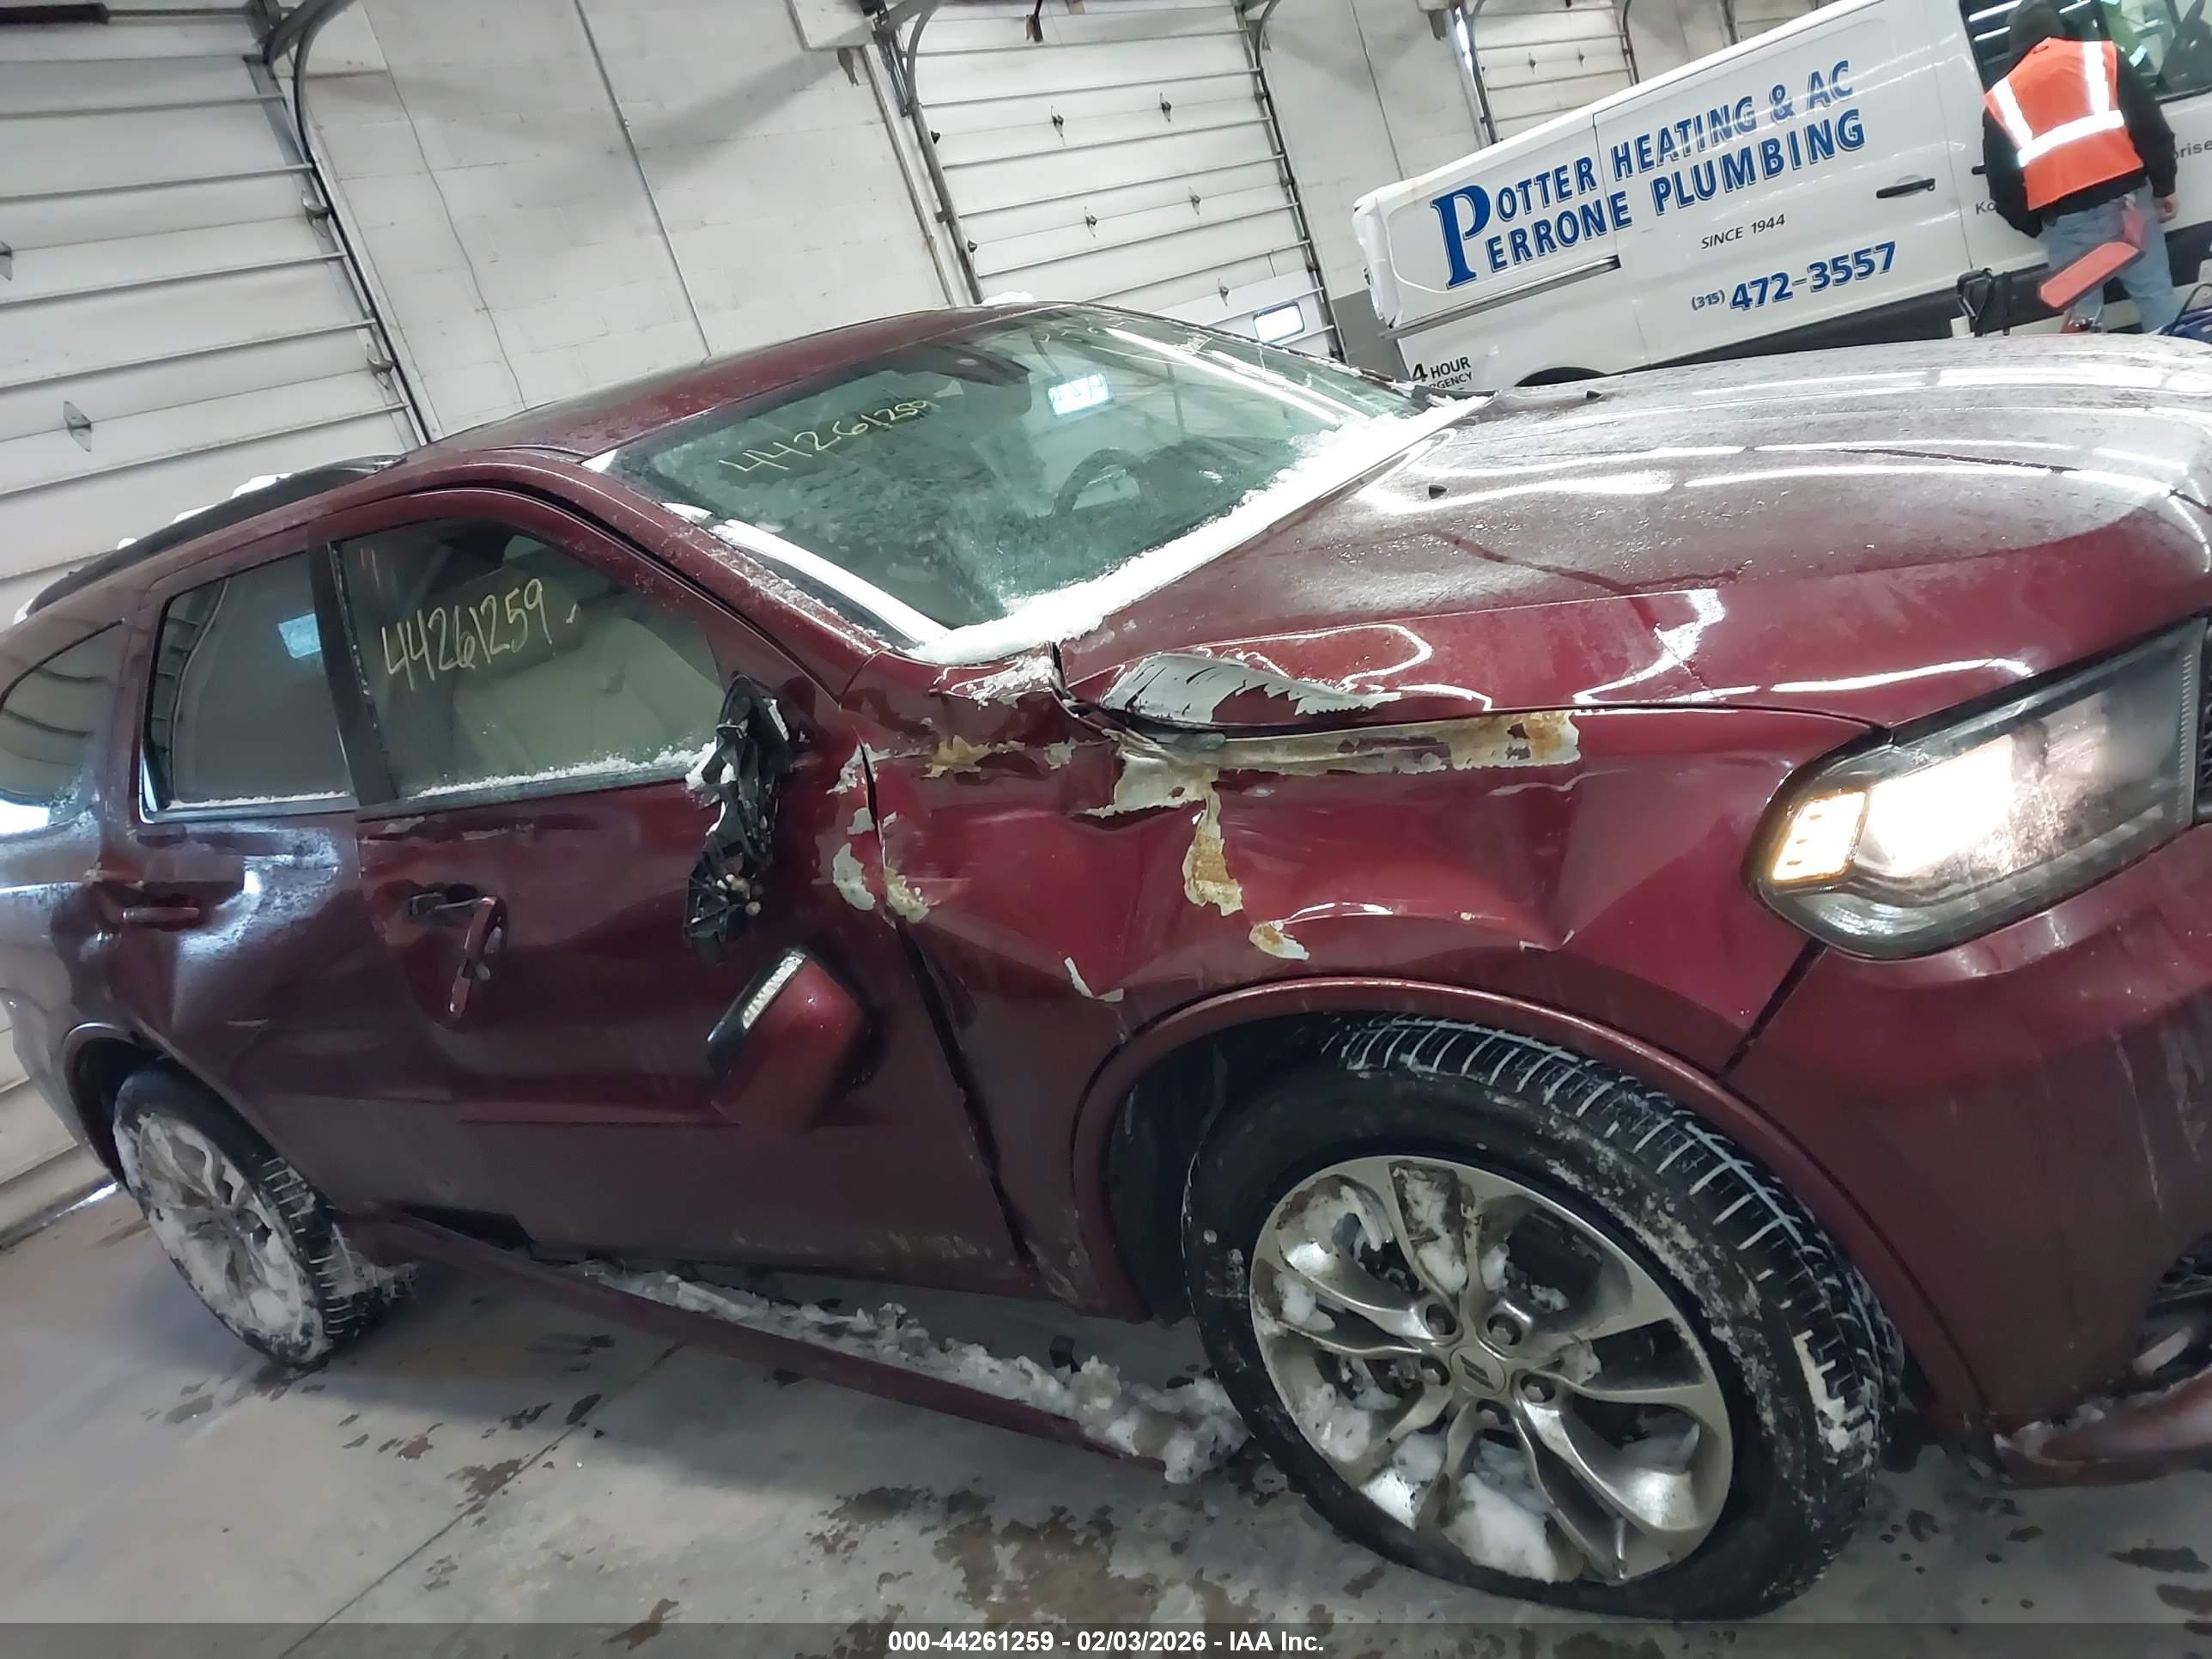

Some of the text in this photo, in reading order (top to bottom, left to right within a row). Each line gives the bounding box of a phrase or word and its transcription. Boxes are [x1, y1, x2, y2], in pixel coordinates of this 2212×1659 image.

[1611, 95, 1757, 182] HEATING
[1770, 84, 1795, 124] &
[1807, 59, 1854, 110] AC
[1650, 109, 1866, 216] PLUMBING
[1701, 213, 1786, 250] SINCE 1944
[1692, 241, 1896, 312] (315) 472-3557
[1430, 356, 1471, 379] HOUR
[381, 578, 552, 691] 44261259
